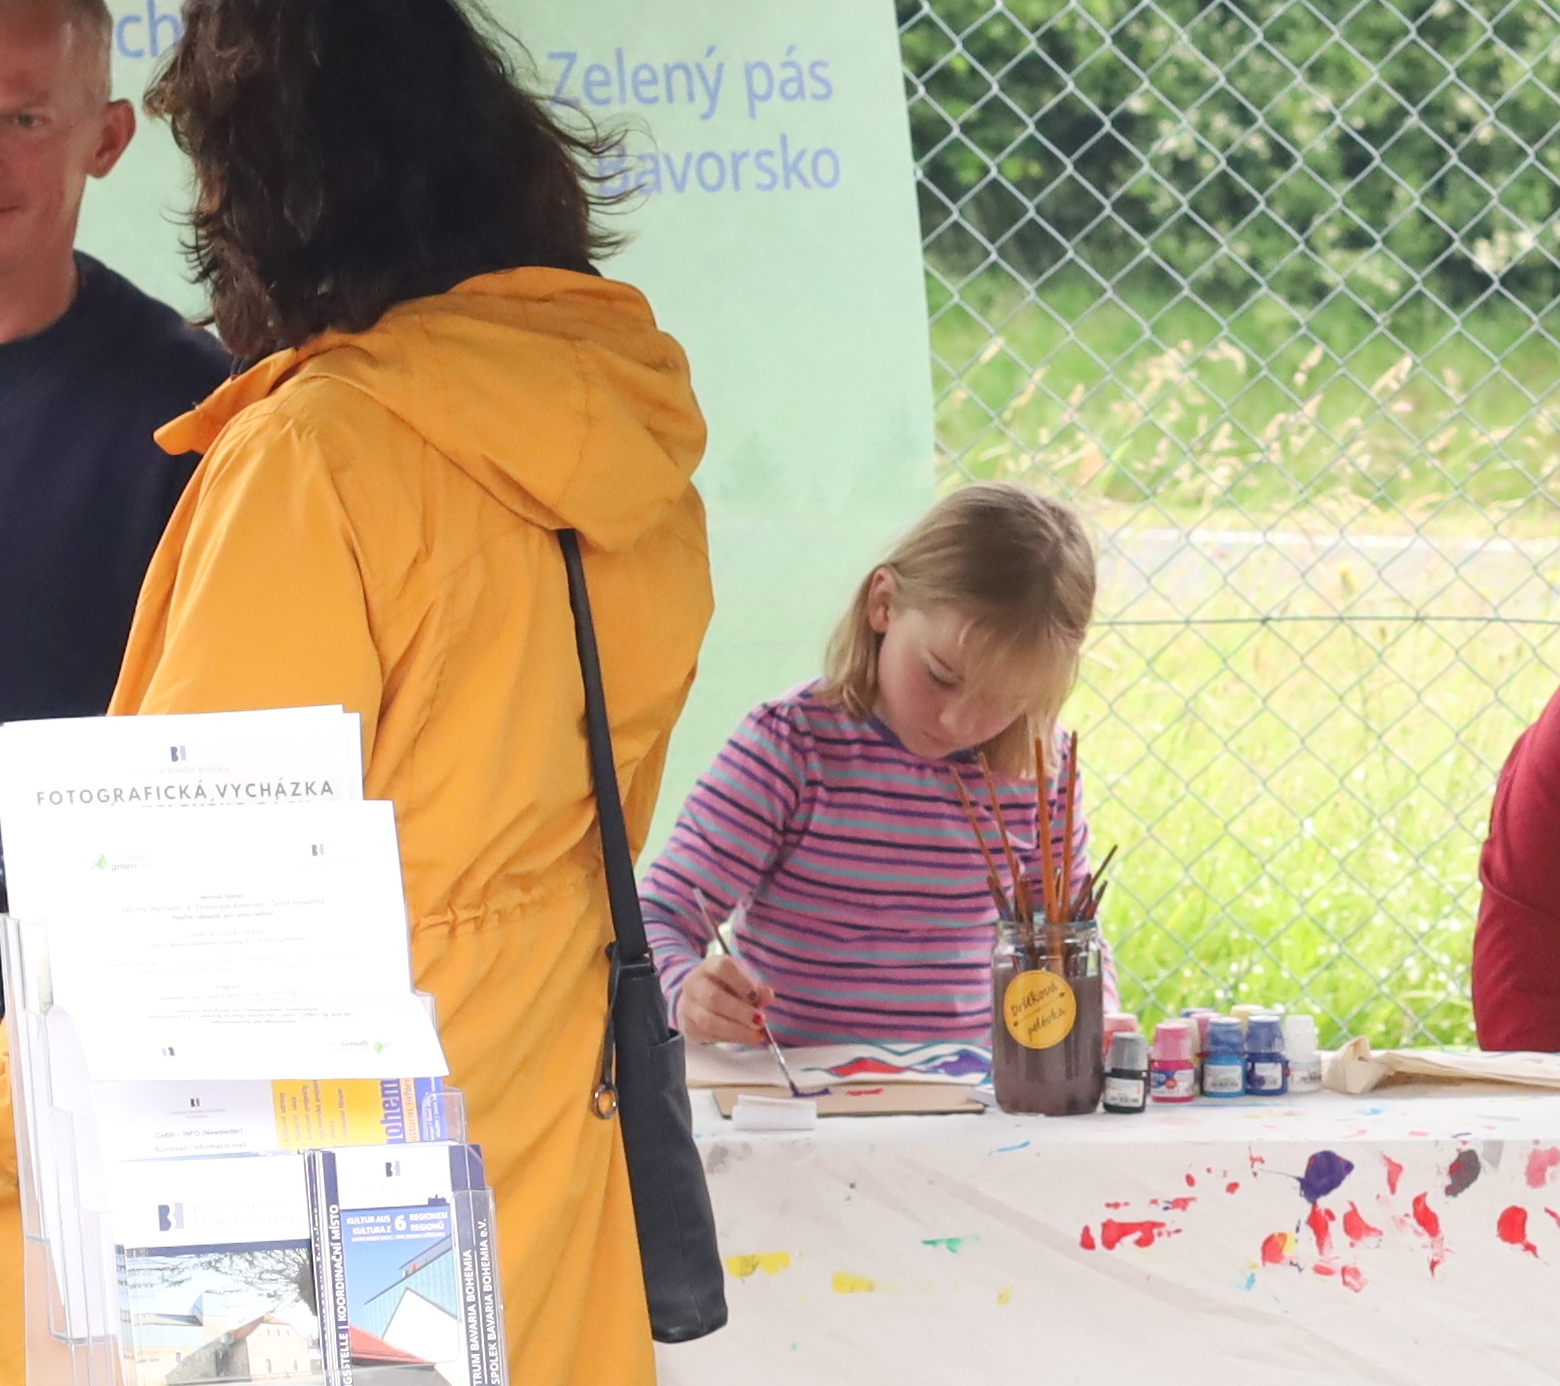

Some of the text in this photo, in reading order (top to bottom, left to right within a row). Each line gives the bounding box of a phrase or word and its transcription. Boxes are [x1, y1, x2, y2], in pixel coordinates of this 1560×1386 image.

[547, 47, 833, 121] Zelený pás
[36, 777, 335, 806] FOTOGRAFICKÁ VYCHÁZKA
[404, 1106, 417, 1142] ulturní
[328, 1204, 341, 1242] MÍSTO
[346, 1215, 391, 1225] KULTUR AUS
[394, 1214, 407, 1232] 6
[333, 1244, 348, 1321] KOORDINAČNÍ
[462, 1250, 477, 1300] BOHEMIA
[483, 1240, 494, 1293] BOHEMIA
[467, 1302, 480, 1353] BAVARIA
[486, 1295, 497, 1343] BAVARIA
[490, 1345, 501, 1386] SPOLEK
